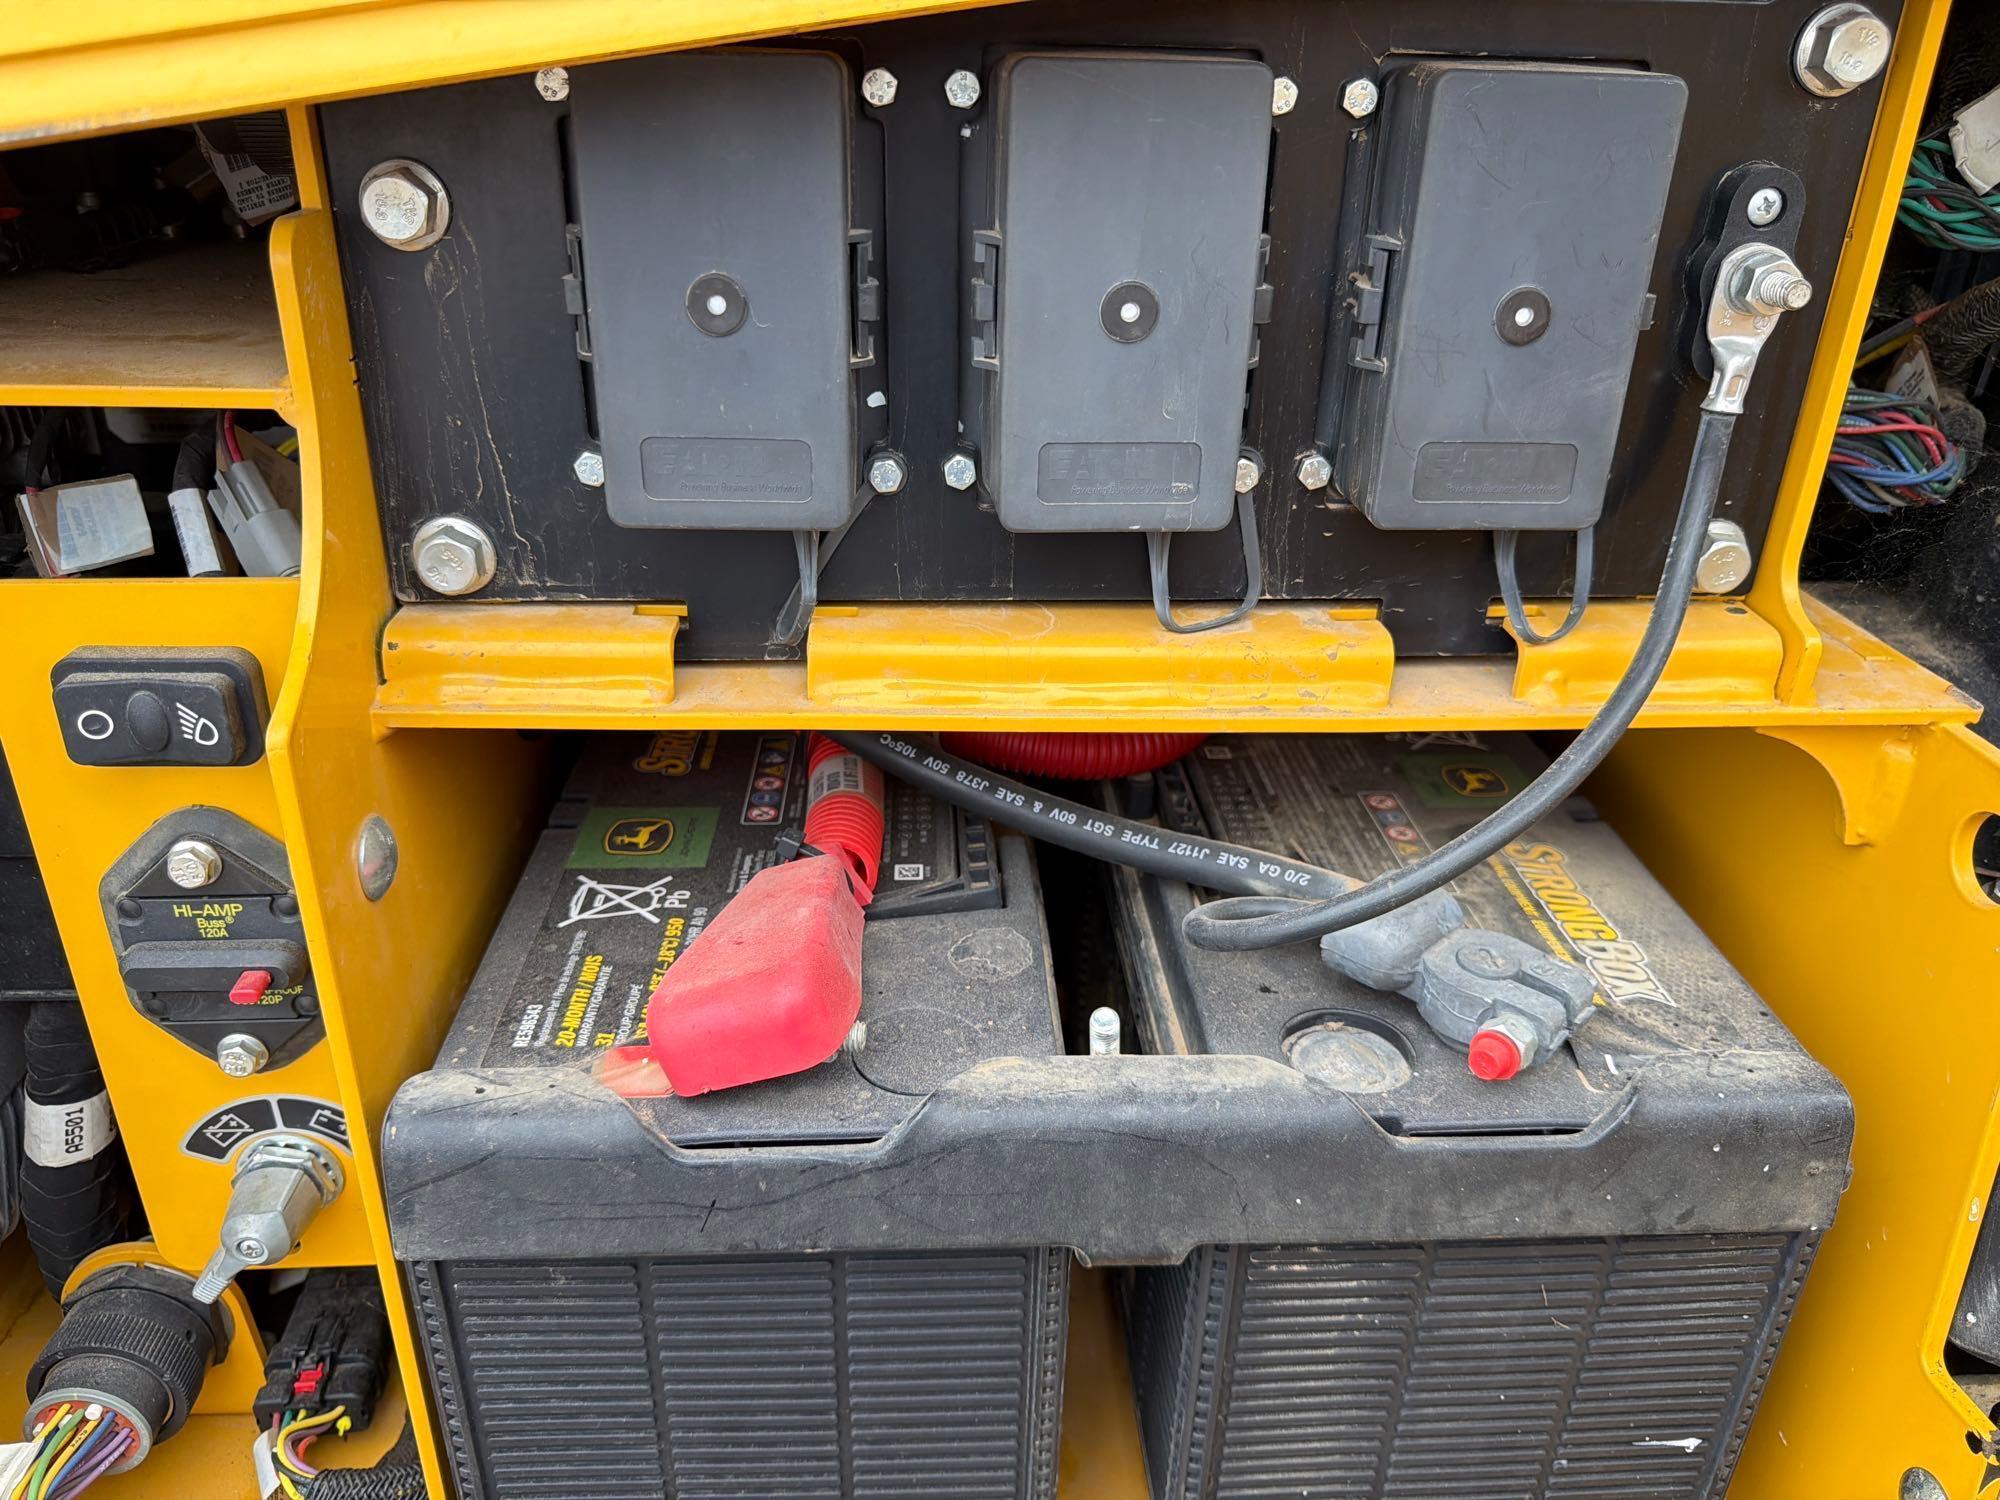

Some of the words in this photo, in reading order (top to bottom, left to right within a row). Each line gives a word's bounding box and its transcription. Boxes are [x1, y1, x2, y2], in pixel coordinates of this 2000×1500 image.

[879, 733, 918, 759] 105°C
[923, 756, 951, 776] 50V
[955, 770, 990, 791] J378
[994, 786, 1026, 807] SAE
[1033, 800, 1044, 814] &
[1049, 807, 1077, 825] 60V
[1083, 818, 1115, 837] SGT
[1120, 829, 1160, 850] TYPE
[1167, 841, 1210, 860] J1127
[1217, 851, 1250, 870] SAE
[1259, 861, 1281, 878] GA
[1284, 869, 1312, 886] 2/0
[664, 889, 691, 909] Pb
[199, 928, 229, 938] 120A
[555, 987, 590, 1048] 20-MONTH
[578, 954, 603, 985] MOIS
[574, 965, 613, 1047] WARRANTY/GARANTIE
[511, 1004, 543, 1048] RE596543
[594, 1031, 616, 1048] 31
[64, 1106, 85, 1155] A5501
